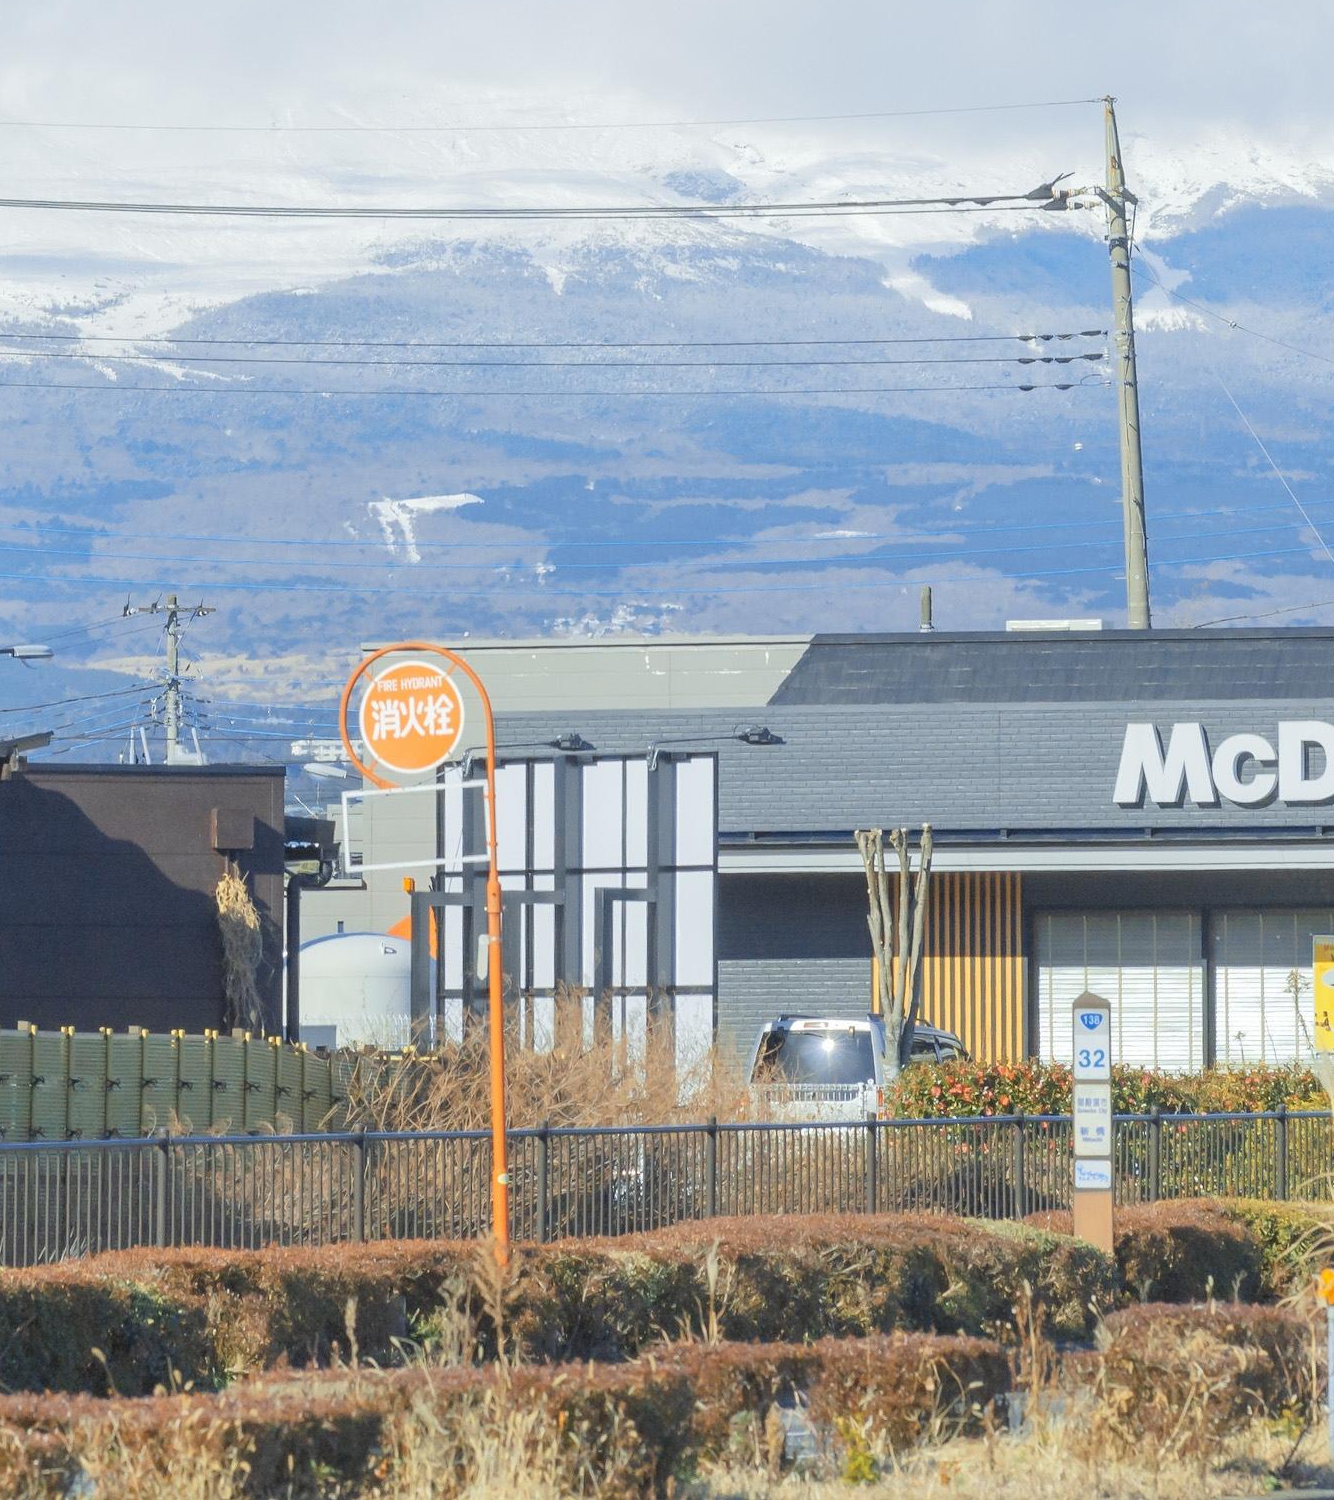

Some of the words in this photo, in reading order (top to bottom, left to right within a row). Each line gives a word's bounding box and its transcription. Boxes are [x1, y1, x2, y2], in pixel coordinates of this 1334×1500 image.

[377, 680, 398, 692] FIRE
[401, 676, 442, 690] HYDRANT
[371, 693, 454, 740] 消火栓
[1083, 1015, 1100, 1025] 138
[1078, 1049, 1105, 1068] 32
